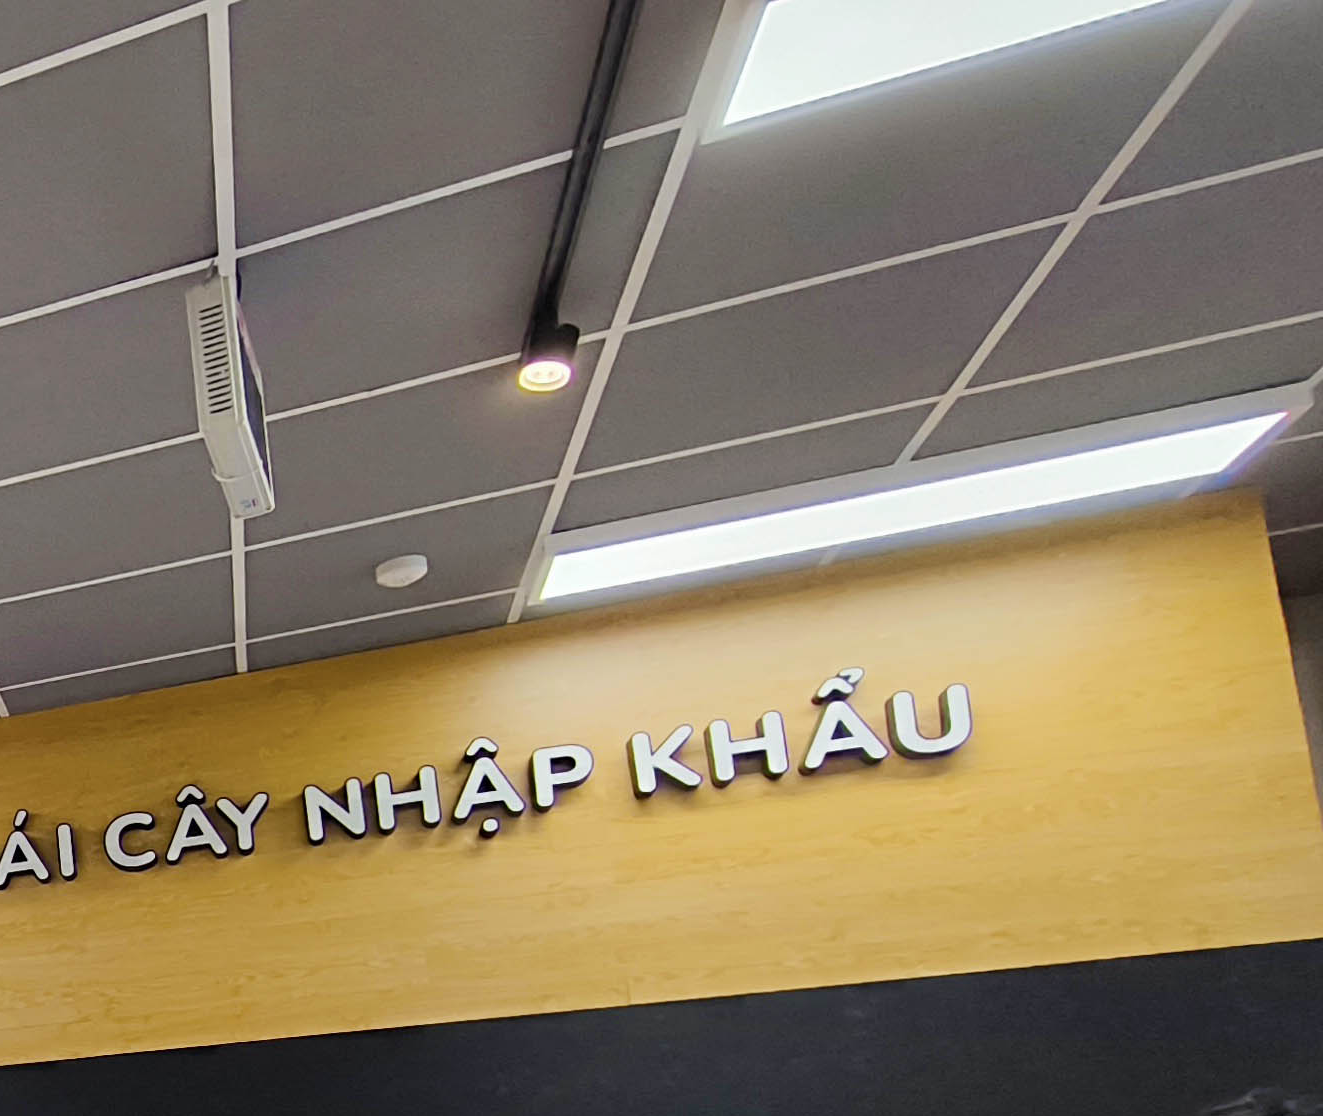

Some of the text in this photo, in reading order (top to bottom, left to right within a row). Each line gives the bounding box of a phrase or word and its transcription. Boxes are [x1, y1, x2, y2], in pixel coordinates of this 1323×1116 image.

[102, 784, 269, 872] CÂY
[303, 737, 594, 846] NHẬP
[628, 667, 974, 799] KHẨU
